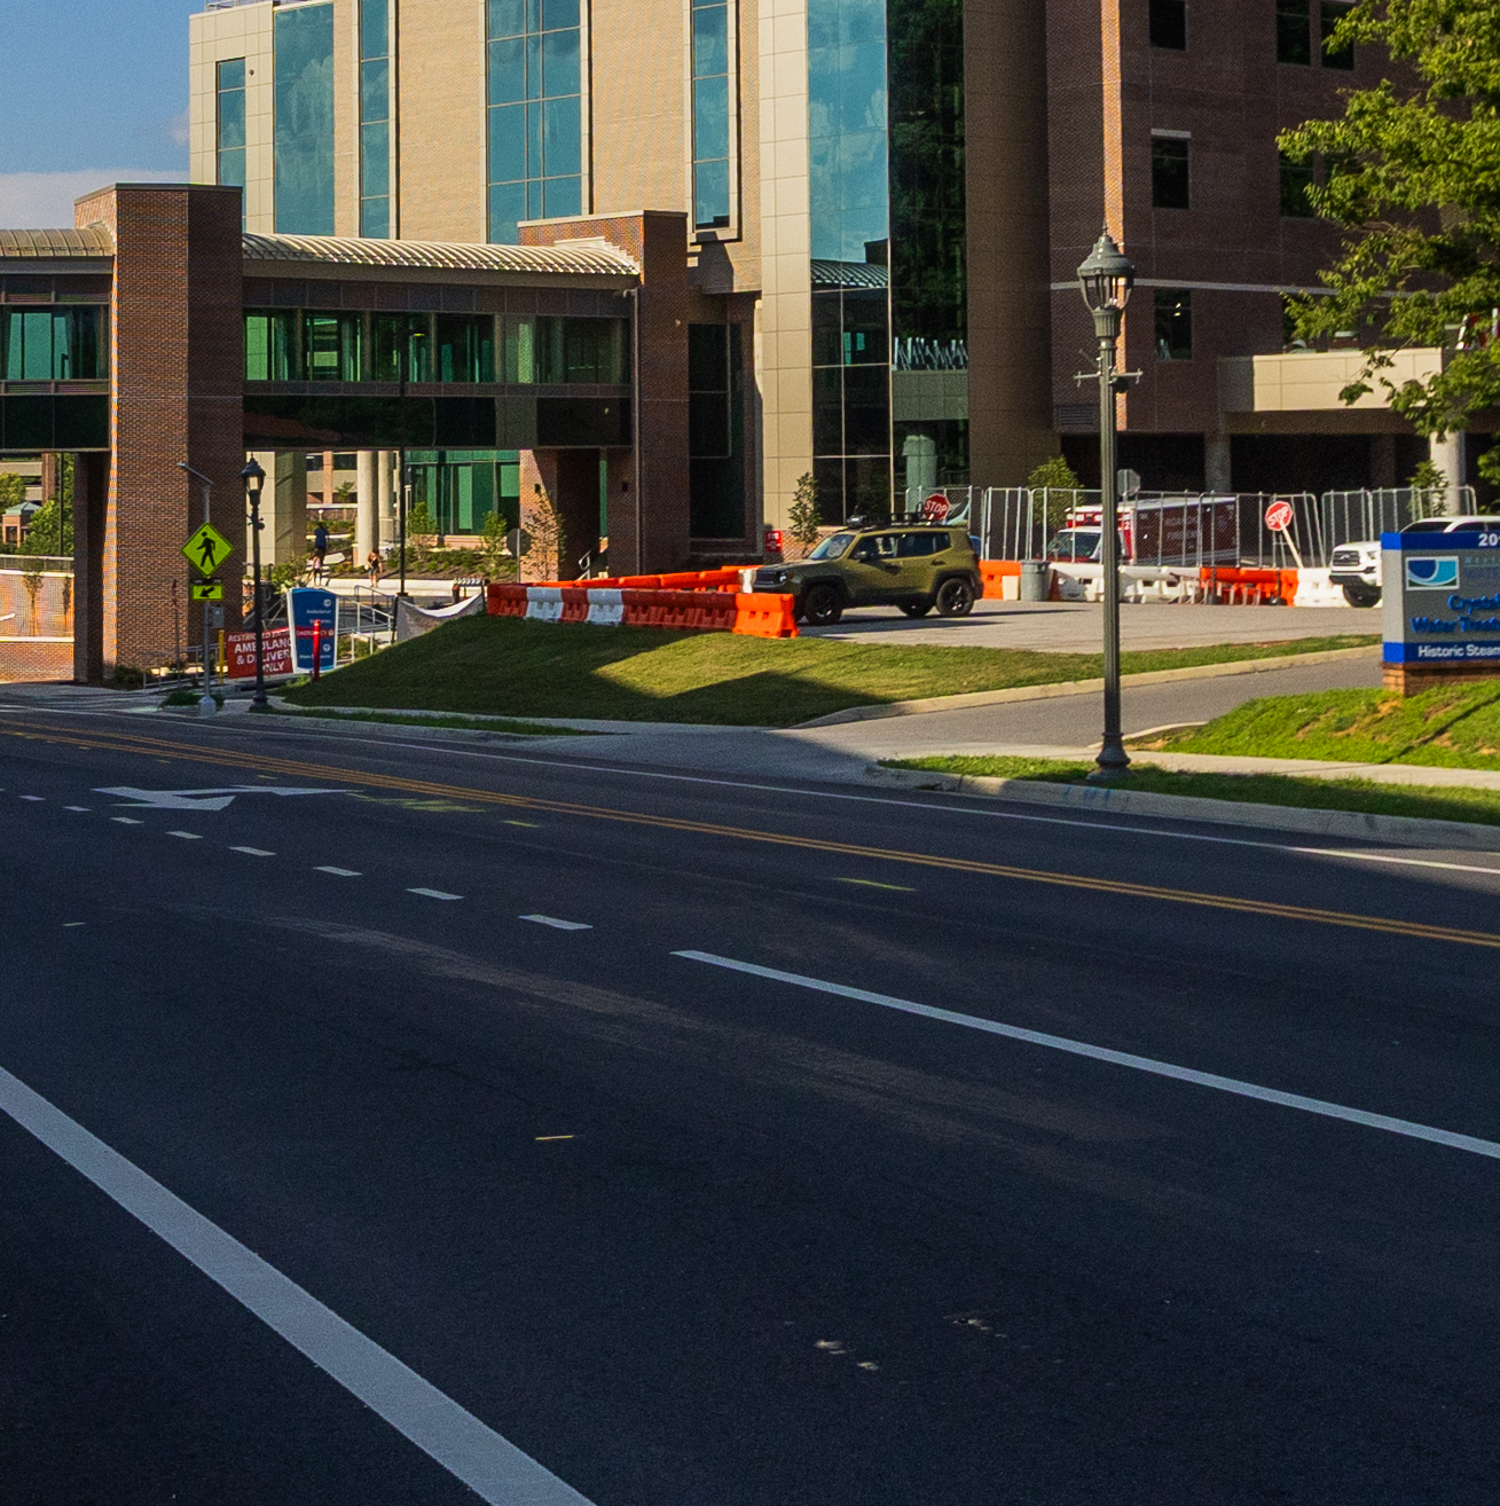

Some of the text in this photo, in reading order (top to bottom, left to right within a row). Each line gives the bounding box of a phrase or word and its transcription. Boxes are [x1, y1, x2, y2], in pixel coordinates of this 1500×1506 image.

[924, 500, 947, 514] STOP
[1268, 505, 1290, 527] STOP
[1447, 593, 1500, 614] Crystal
[1410, 616, 1456, 632] Water
[1418, 645, 1464, 658] Historic
[237, 655, 245, 665] &
